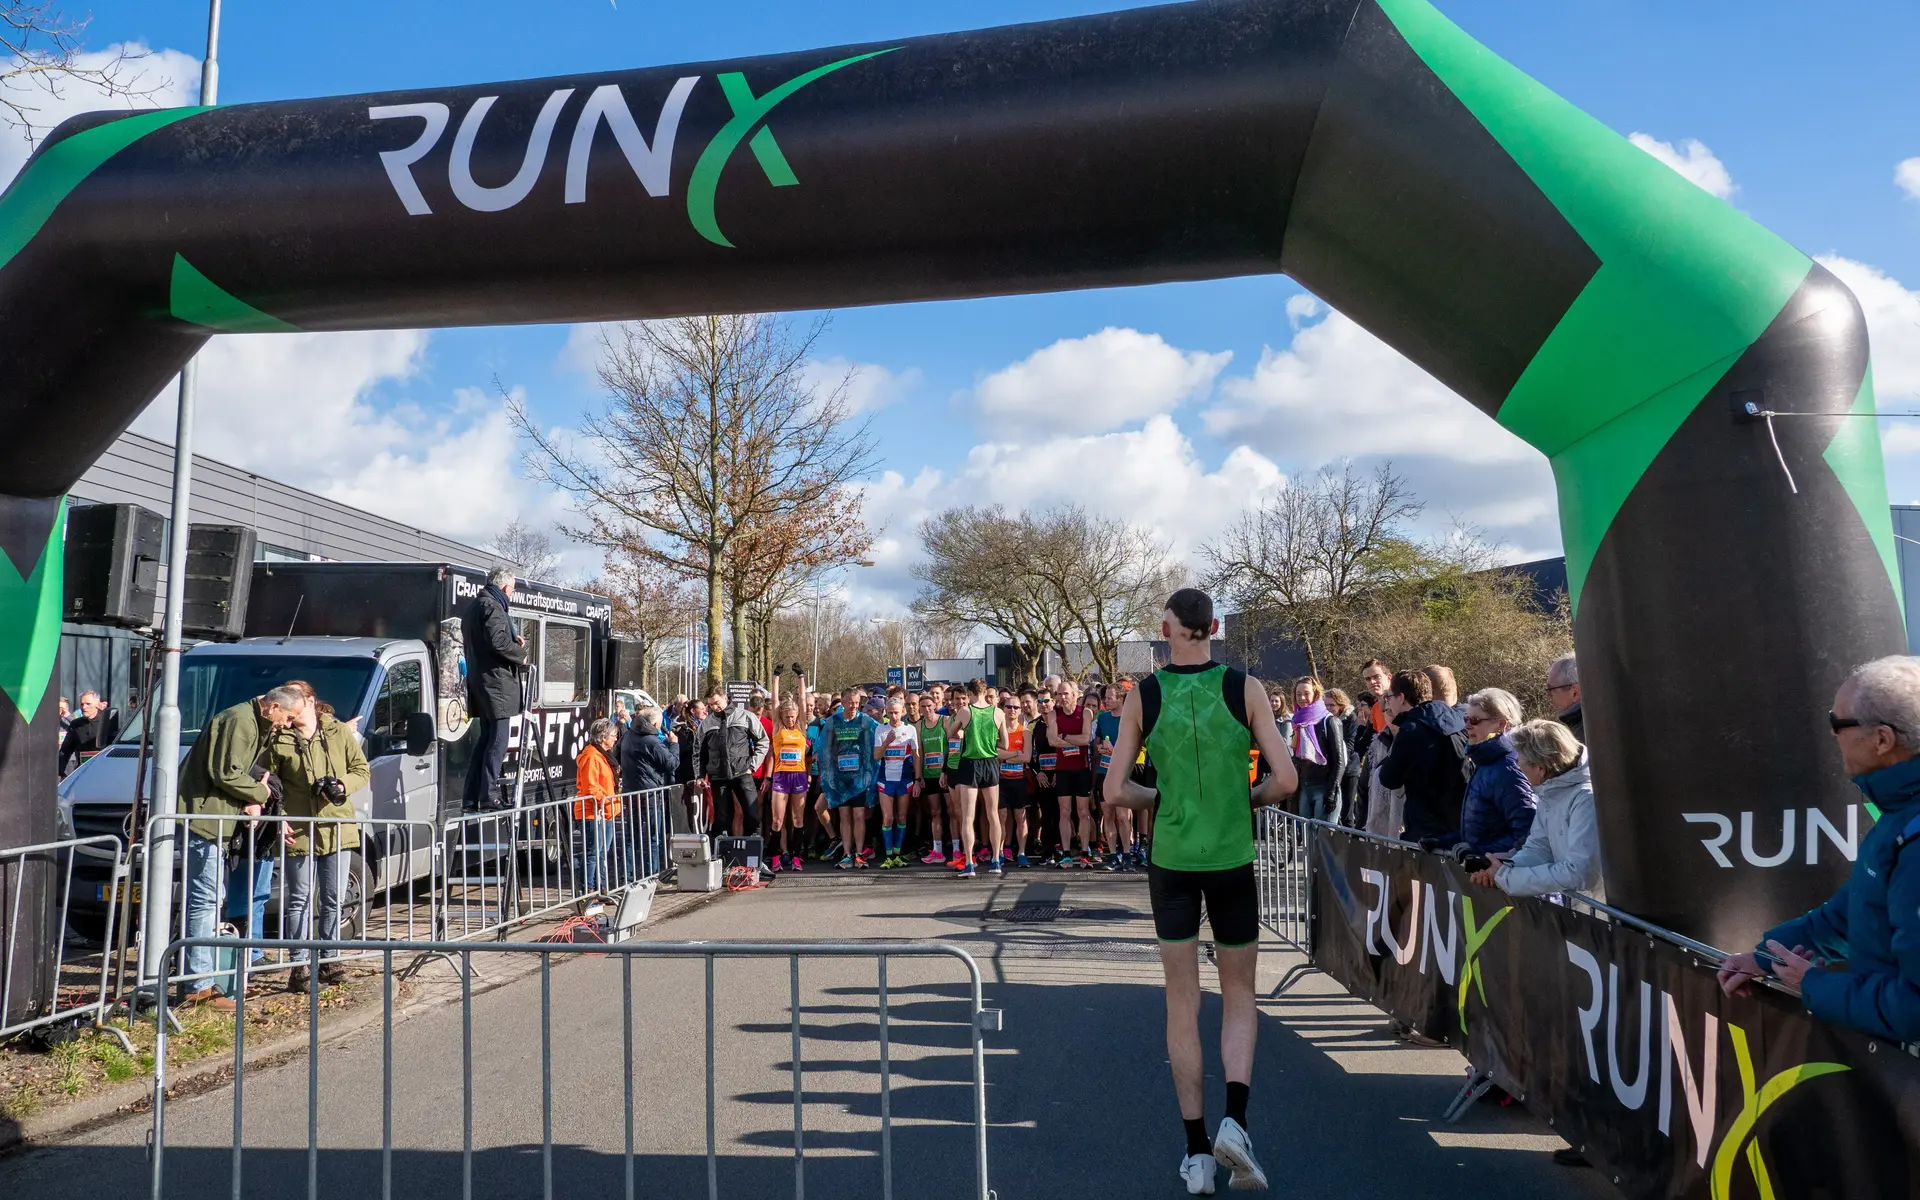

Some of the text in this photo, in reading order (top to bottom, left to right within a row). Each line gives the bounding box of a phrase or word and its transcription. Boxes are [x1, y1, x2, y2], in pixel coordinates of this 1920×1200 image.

[369, 47, 904, 248] RUNX
[456, 581, 484, 598] CRAF
[1682, 803, 1883, 868] RUN
[1360, 867, 1514, 1036] RUNX
[1566, 940, 1851, 1200] RUNX
